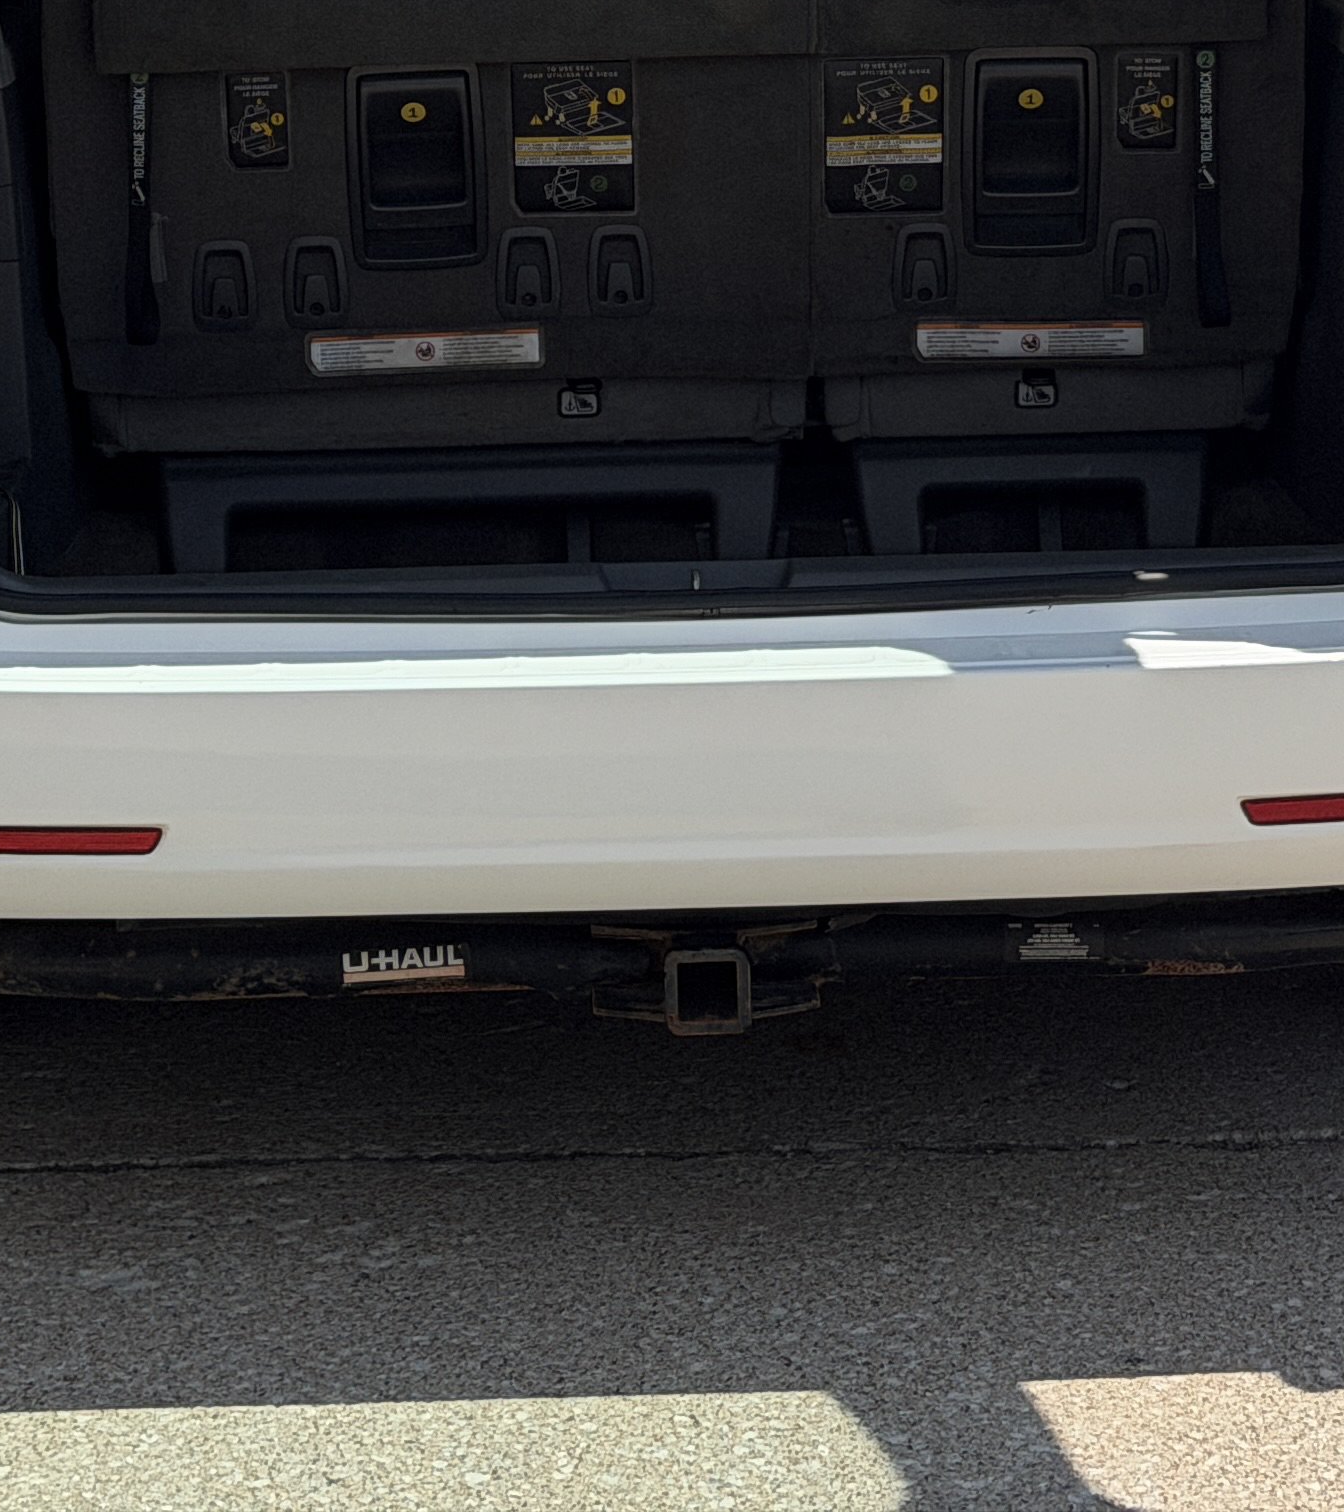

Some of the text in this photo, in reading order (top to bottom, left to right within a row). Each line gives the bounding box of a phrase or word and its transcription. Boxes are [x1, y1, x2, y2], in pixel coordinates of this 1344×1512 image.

[133, 86, 145, 130] SEATBACK
[1200, 71, 1212, 114] SEATBACK
[133, 132, 145, 167] RECLINE
[1200, 116, 1213, 150] RECLINE
[342, 944, 464, 973] U-HAUL
